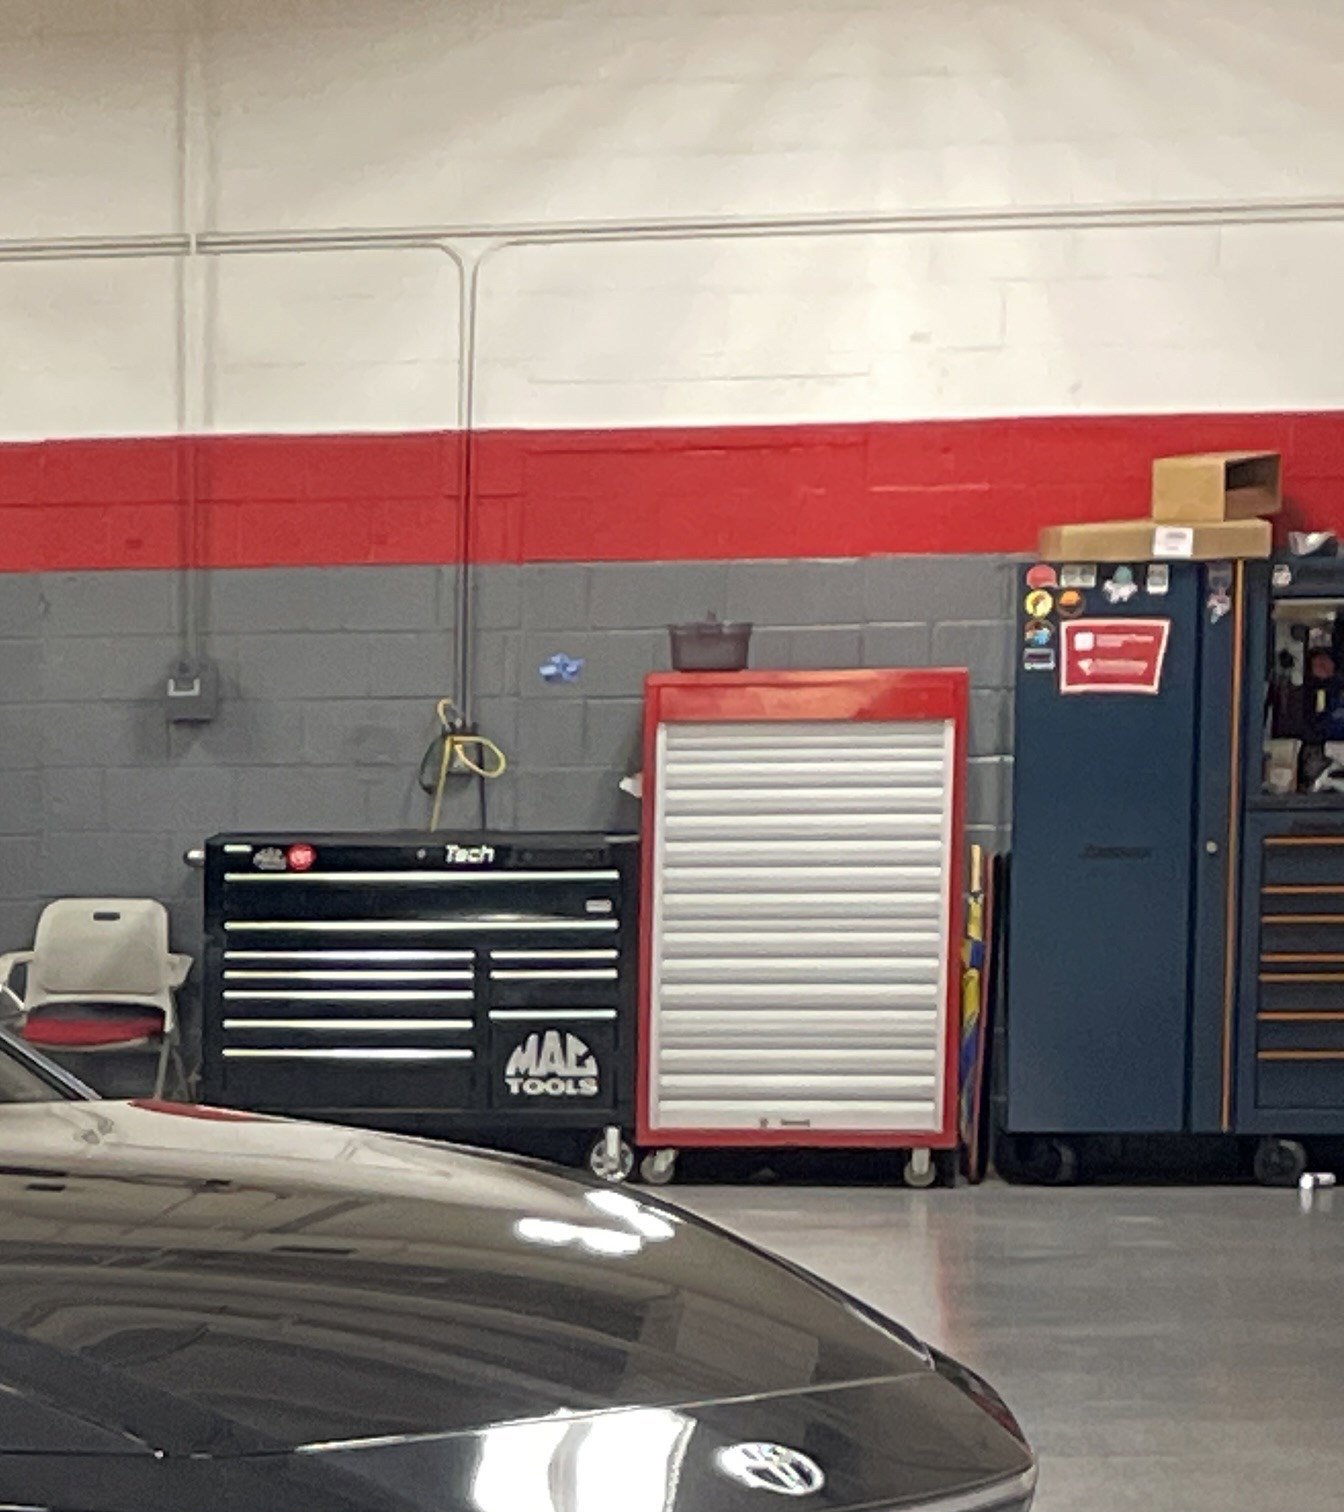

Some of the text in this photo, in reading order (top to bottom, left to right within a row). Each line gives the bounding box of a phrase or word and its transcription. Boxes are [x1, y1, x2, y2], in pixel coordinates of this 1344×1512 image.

[445, 844, 495, 864] Tech
[505, 1030, 598, 1077] MAC
[504, 1077, 599, 1096] TOOLS
